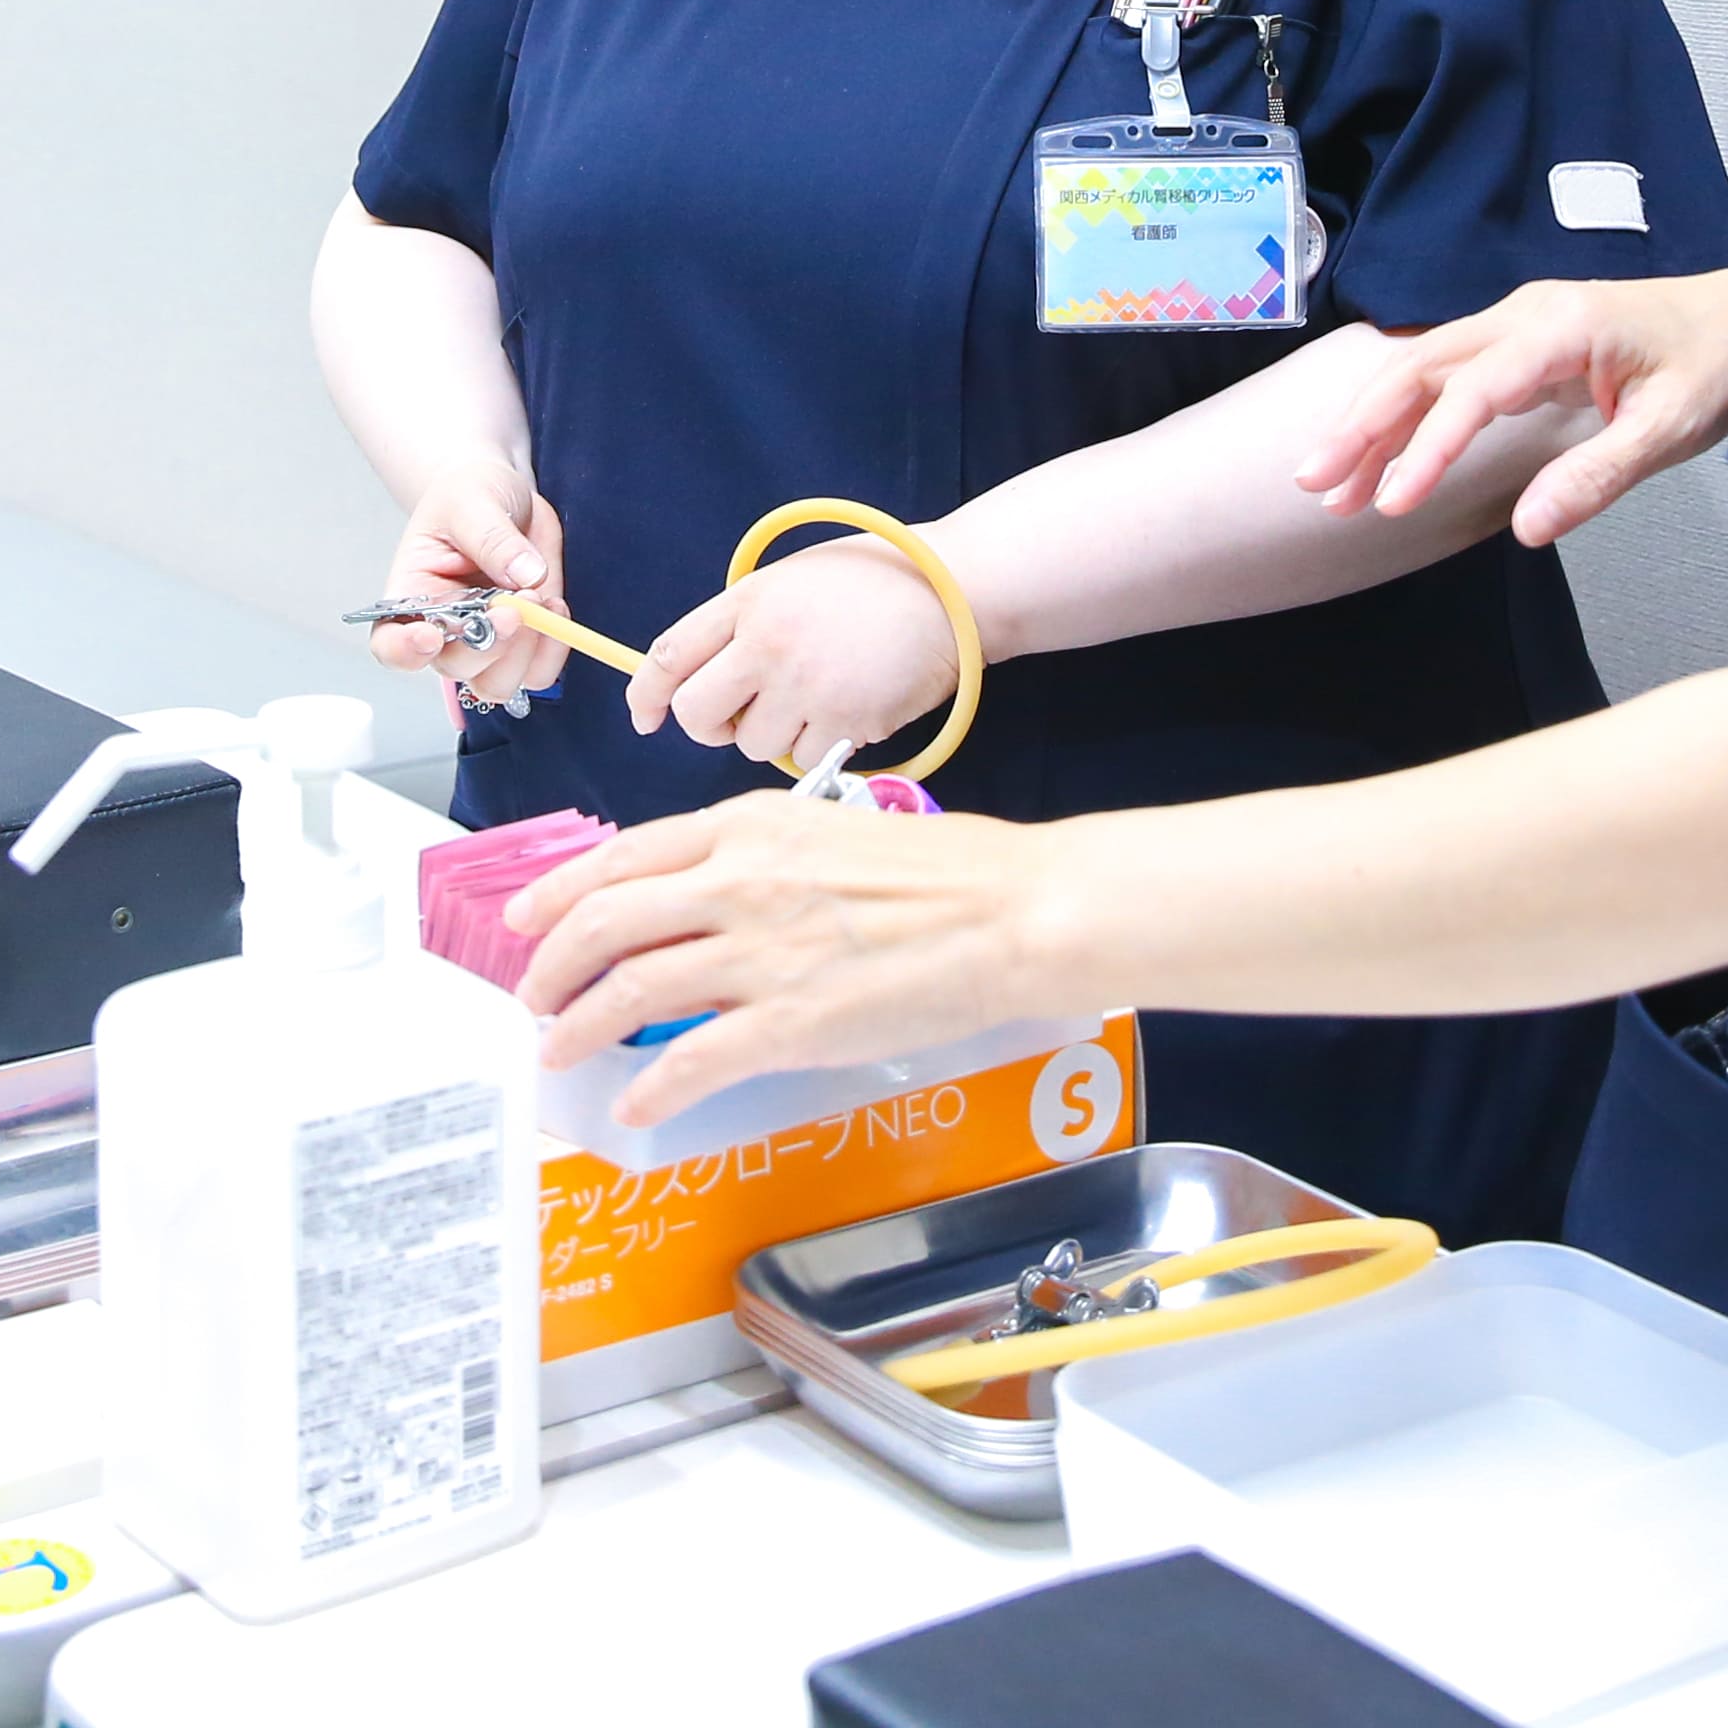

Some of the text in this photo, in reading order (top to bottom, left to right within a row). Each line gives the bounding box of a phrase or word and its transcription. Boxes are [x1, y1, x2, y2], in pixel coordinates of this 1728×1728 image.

[1131, 224, 1178, 241] 看護師
[1060, 1069, 1096, 1137] S
[540, 1216, 697, 1276] ダーフリー
